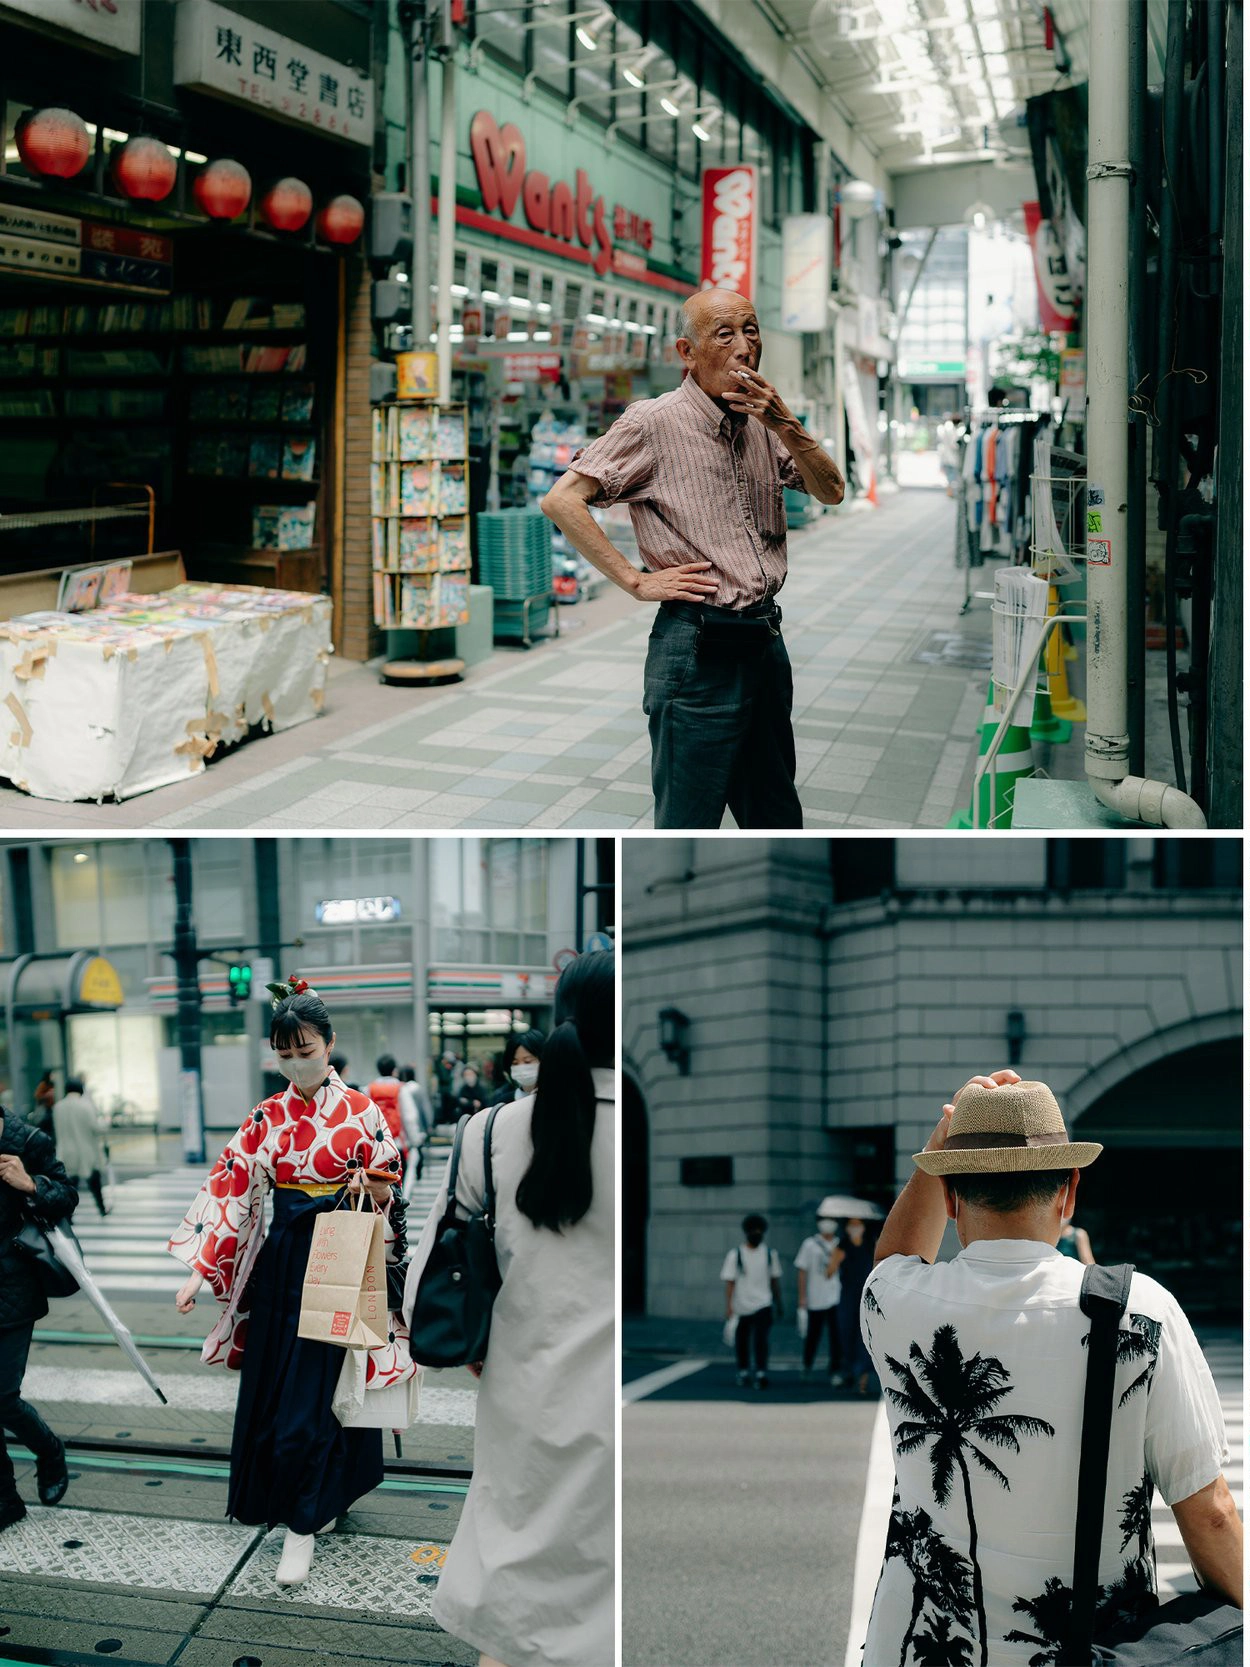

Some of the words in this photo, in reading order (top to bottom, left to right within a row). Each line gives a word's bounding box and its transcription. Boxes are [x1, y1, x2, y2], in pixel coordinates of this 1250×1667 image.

[215, 25, 366, 119] 東西堂書店
[471, 109, 613, 277] Wants
[307, 1274, 321, 1288] Day
[366, 1265, 377, 1320] LONDON
